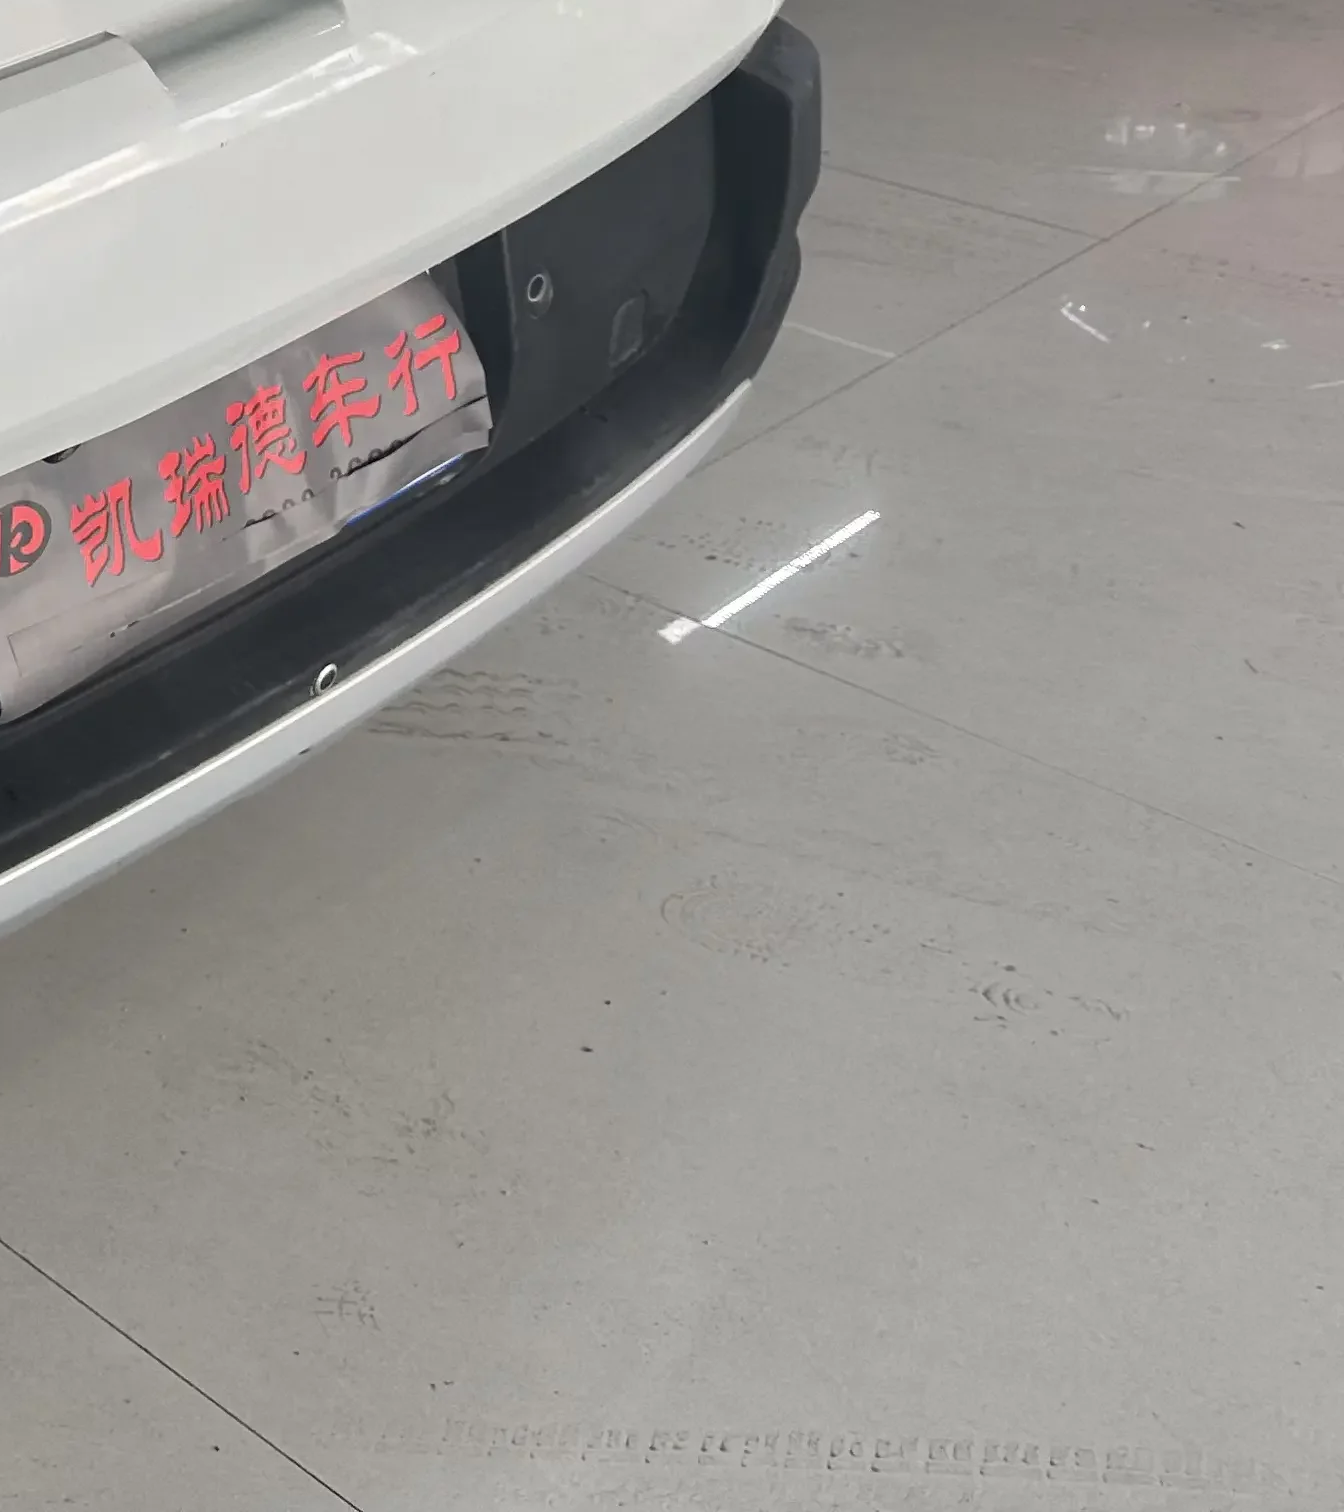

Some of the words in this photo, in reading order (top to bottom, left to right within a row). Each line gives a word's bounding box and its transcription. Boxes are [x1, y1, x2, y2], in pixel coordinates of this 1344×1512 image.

[70, 314, 461, 587] 凯瑞德车行
